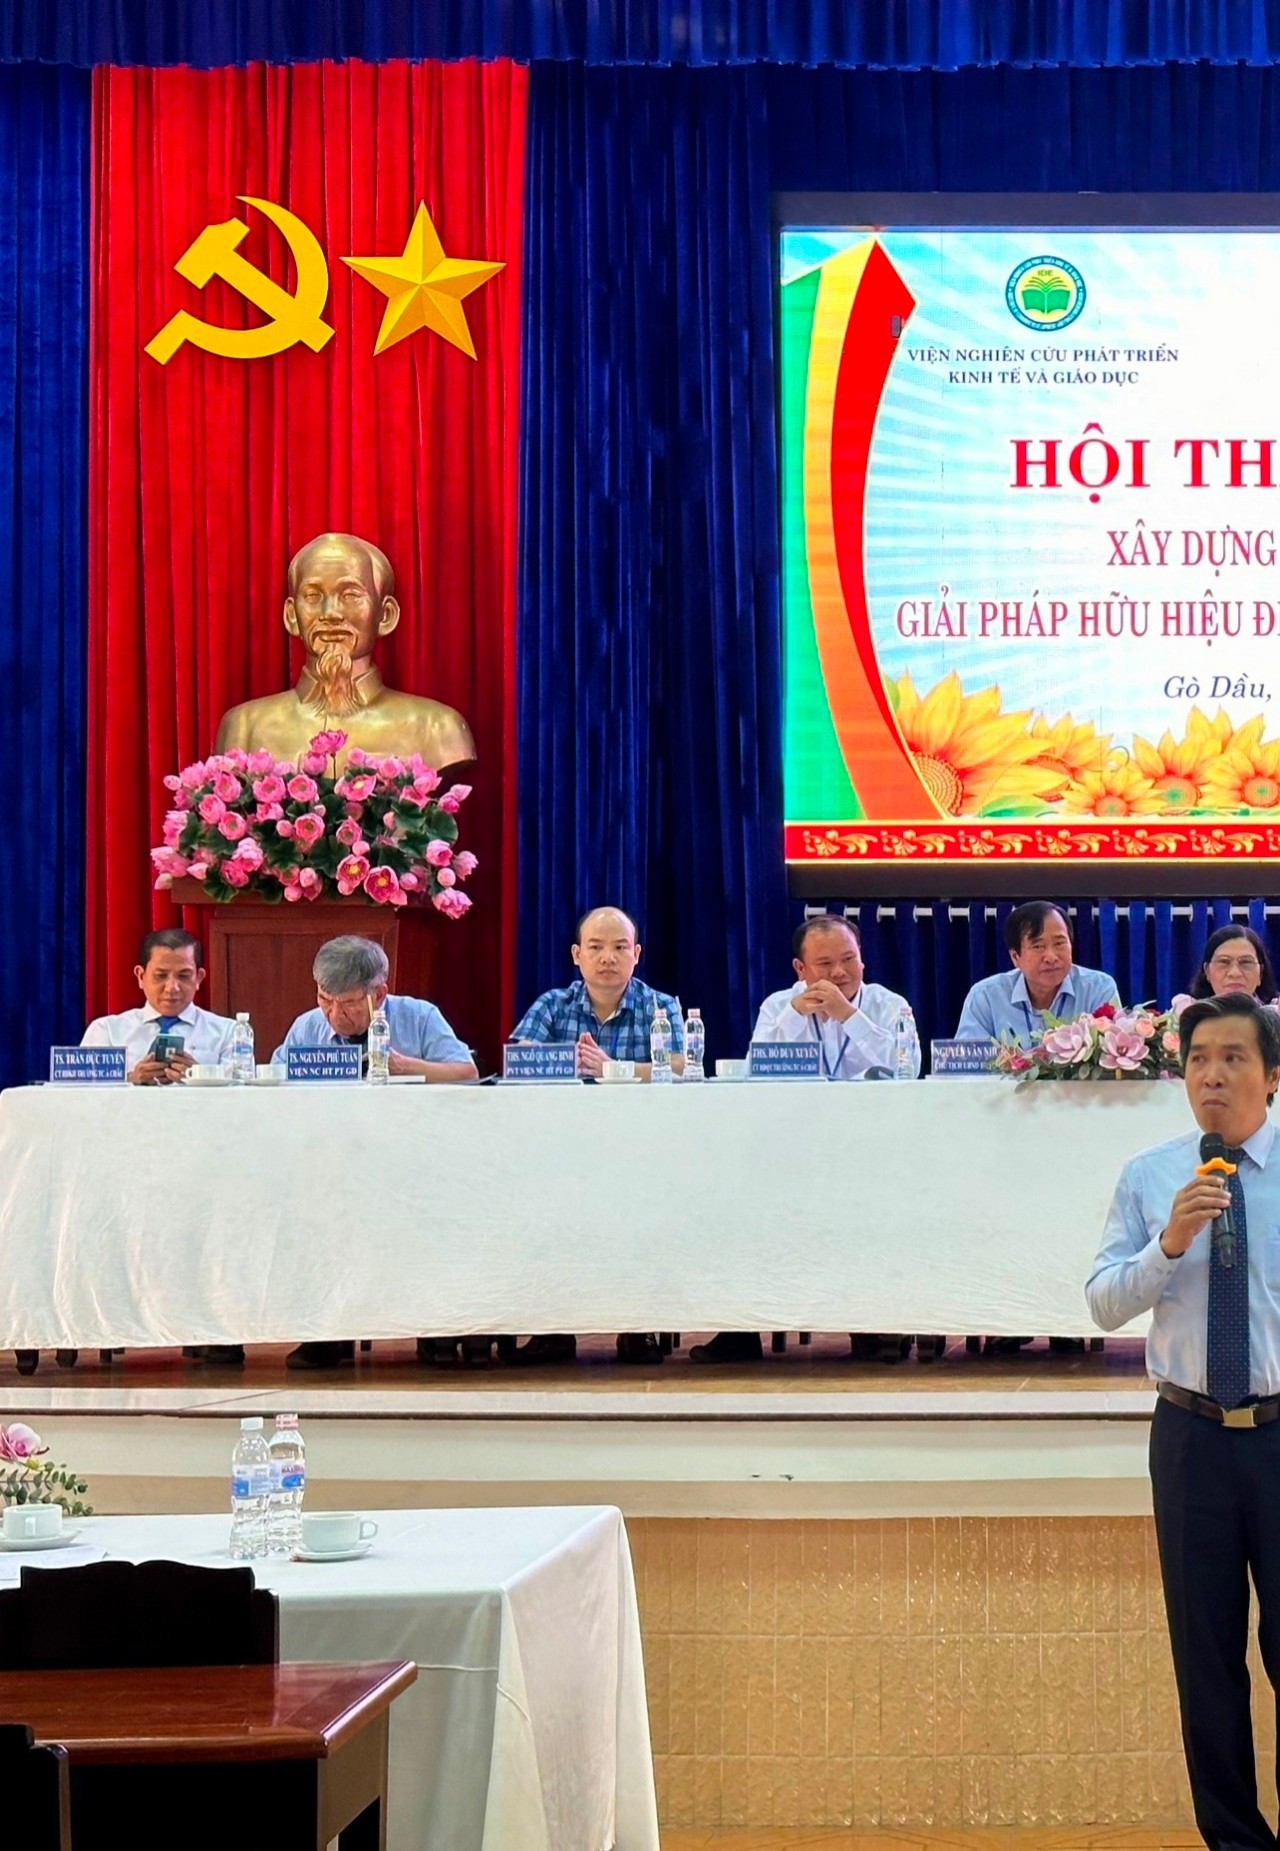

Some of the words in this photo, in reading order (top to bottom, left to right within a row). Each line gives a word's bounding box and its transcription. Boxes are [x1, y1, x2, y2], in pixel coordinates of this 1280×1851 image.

[908, 346, 950, 364] VIỆN
[956, 346, 1025, 362] NGHIÊN
[1031, 346, 1068, 362] CỨU
[1073, 346, 1121, 362] PHÁT
[1125, 342, 1179, 362] TRIỂN
[949, 371, 993, 384] KINH
[998, 366, 1021, 384] TẾ
[1026, 367, 1049, 384] VÀ
[1053, 367, 1097, 384] GIÁO
[1102, 371, 1140, 387] DỤC
[1010, 422, 1151, 506] HỘI
[1107, 518, 1173, 566] XÂY
[1182, 524, 1276, 577] DỰNG
[897, 585, 968, 638] GIẢI
[979, 590, 1069, 638] PHÁP
[1079, 590, 1150, 638] HỮU
[1161, 589, 1243, 647] HIỆU
[1163, 675, 1200, 699] Gò
[1210, 672, 1273, 702] Dầu,
